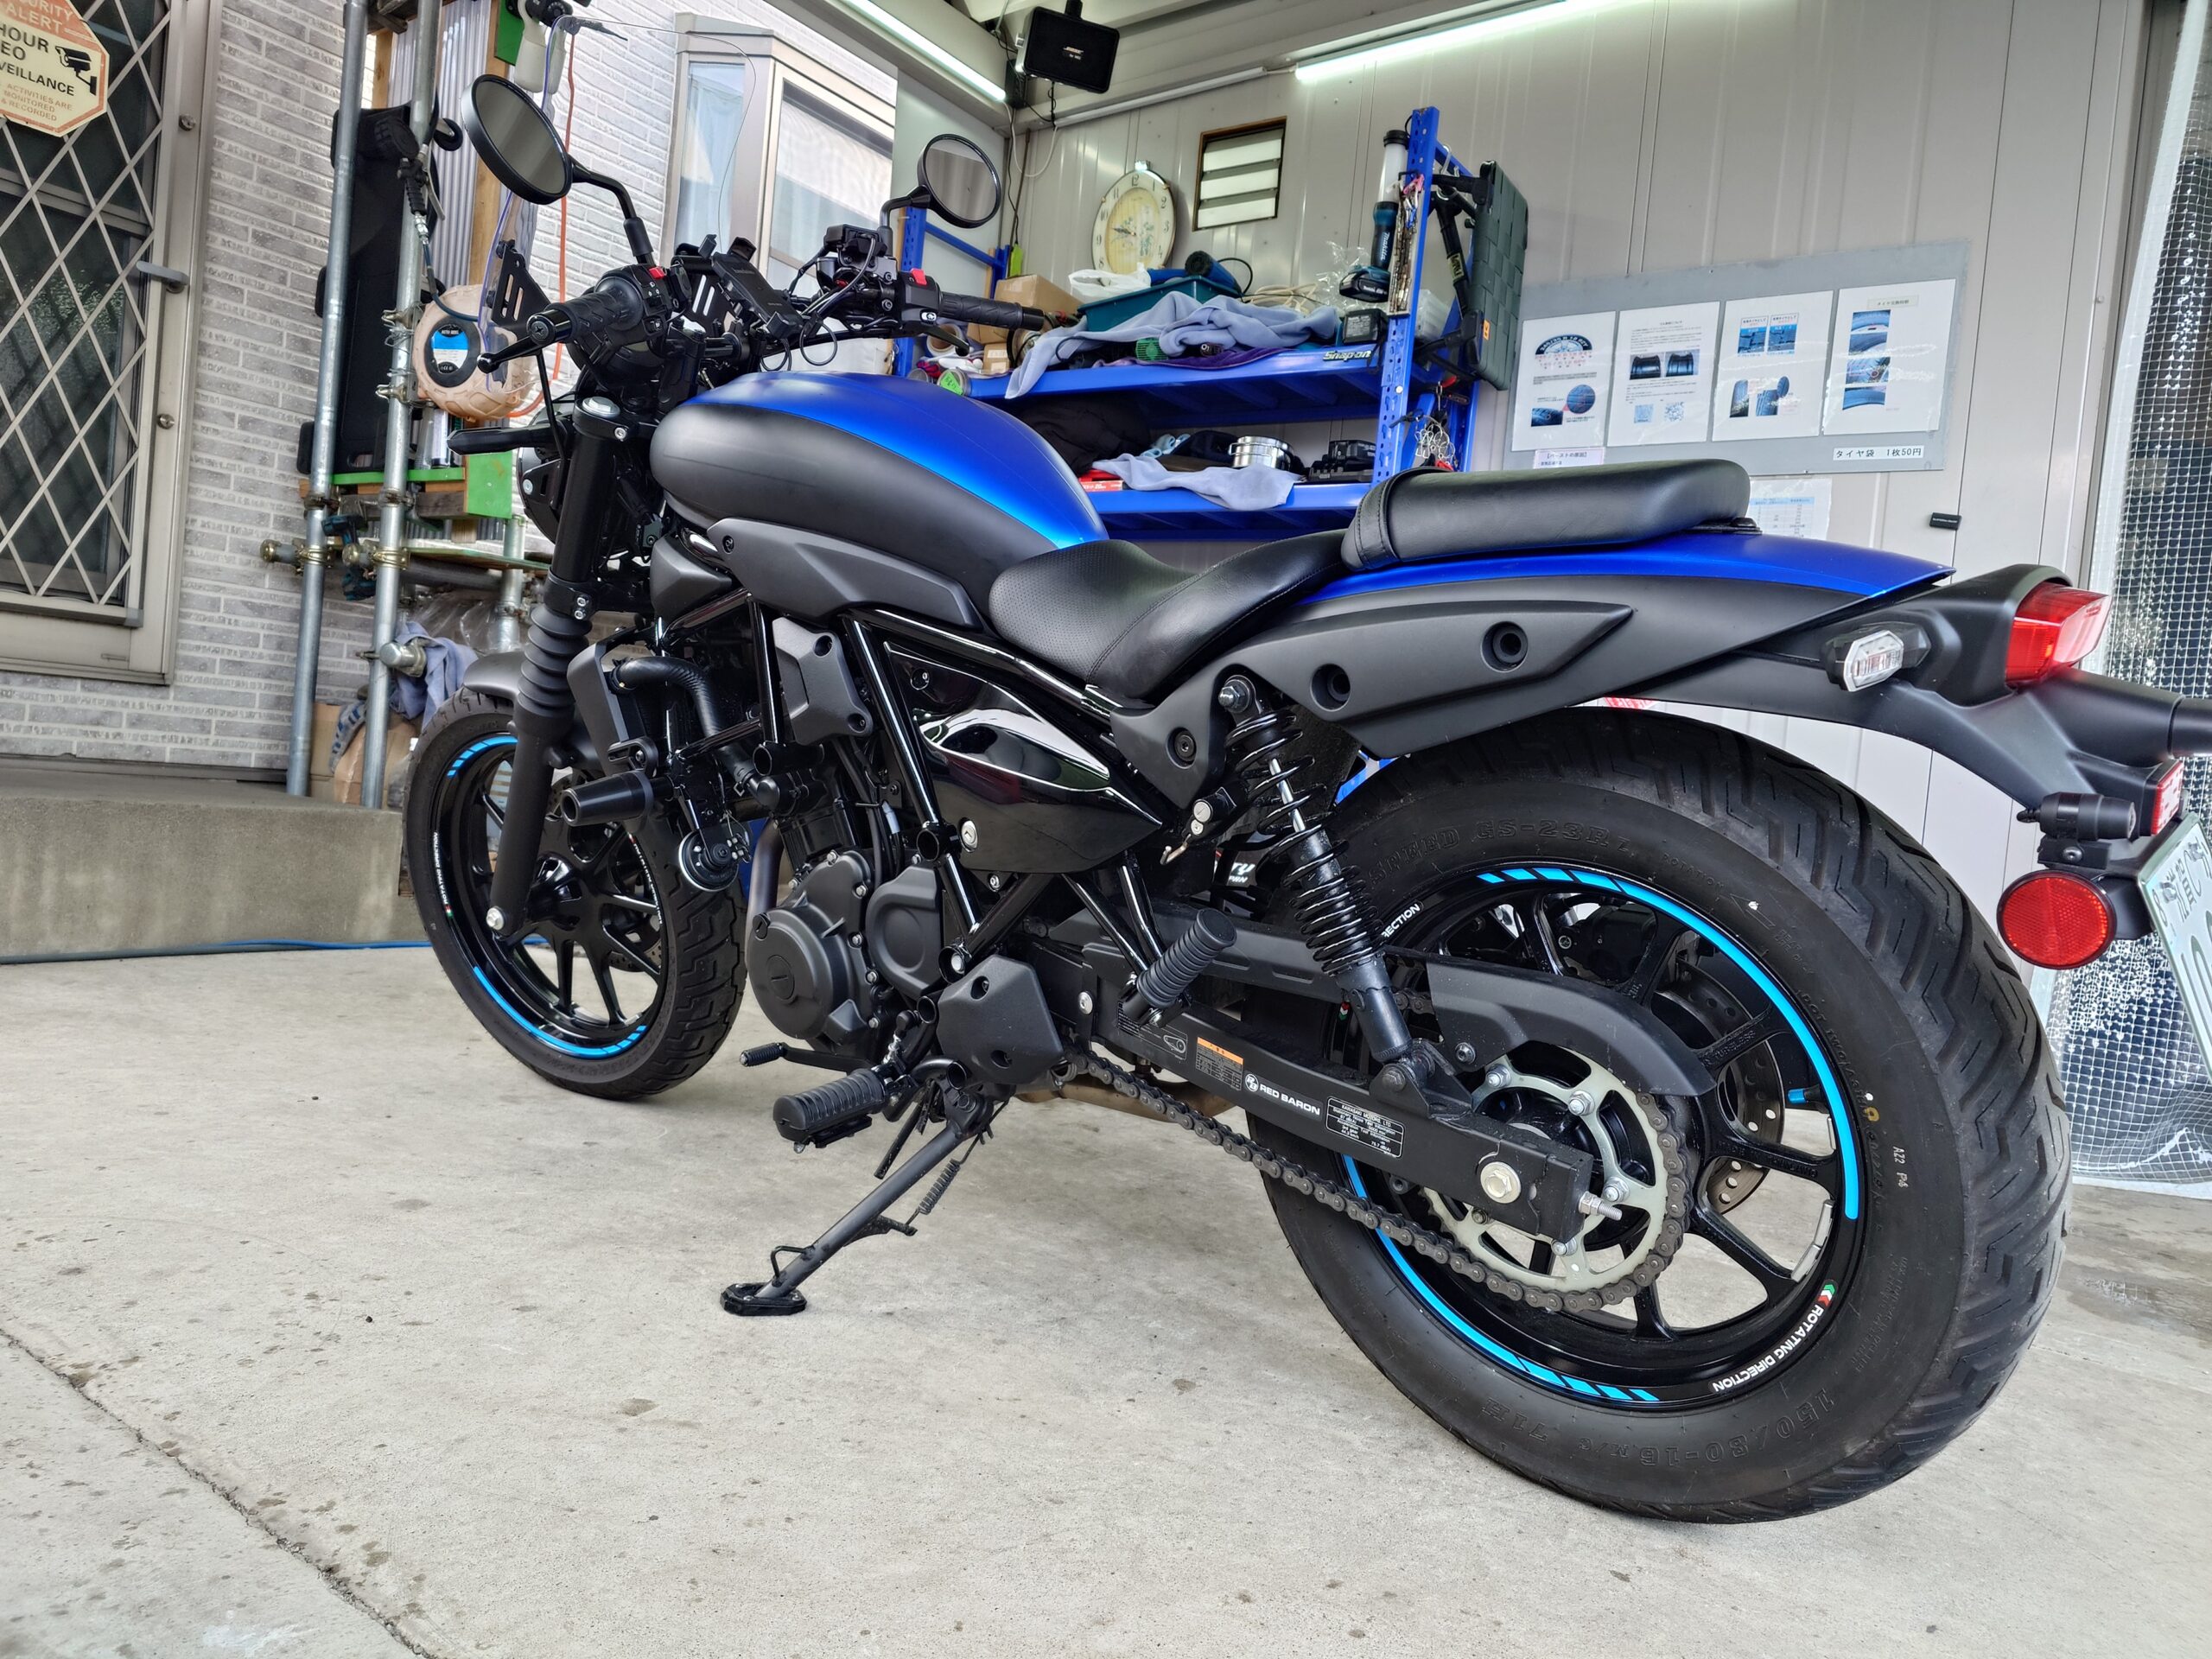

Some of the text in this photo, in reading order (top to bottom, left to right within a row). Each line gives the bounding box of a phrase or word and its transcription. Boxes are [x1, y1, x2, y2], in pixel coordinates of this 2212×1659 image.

[6, 3, 62, 34] ALERT
[3, 90, 55, 112] MONITORED
[8, 99, 57, 122] RECORDED
[54, 99, 73, 111] ARE
[1835, 448, 1922, 458] タイヤ袋 1枚50円
[1260, 1084, 1280, 1098] RED
[1281, 1093, 1320, 1116] BARON
[1774, 1304, 1825, 1360] ROTATING
[1712, 1355, 1777, 1393] DIRECTION
